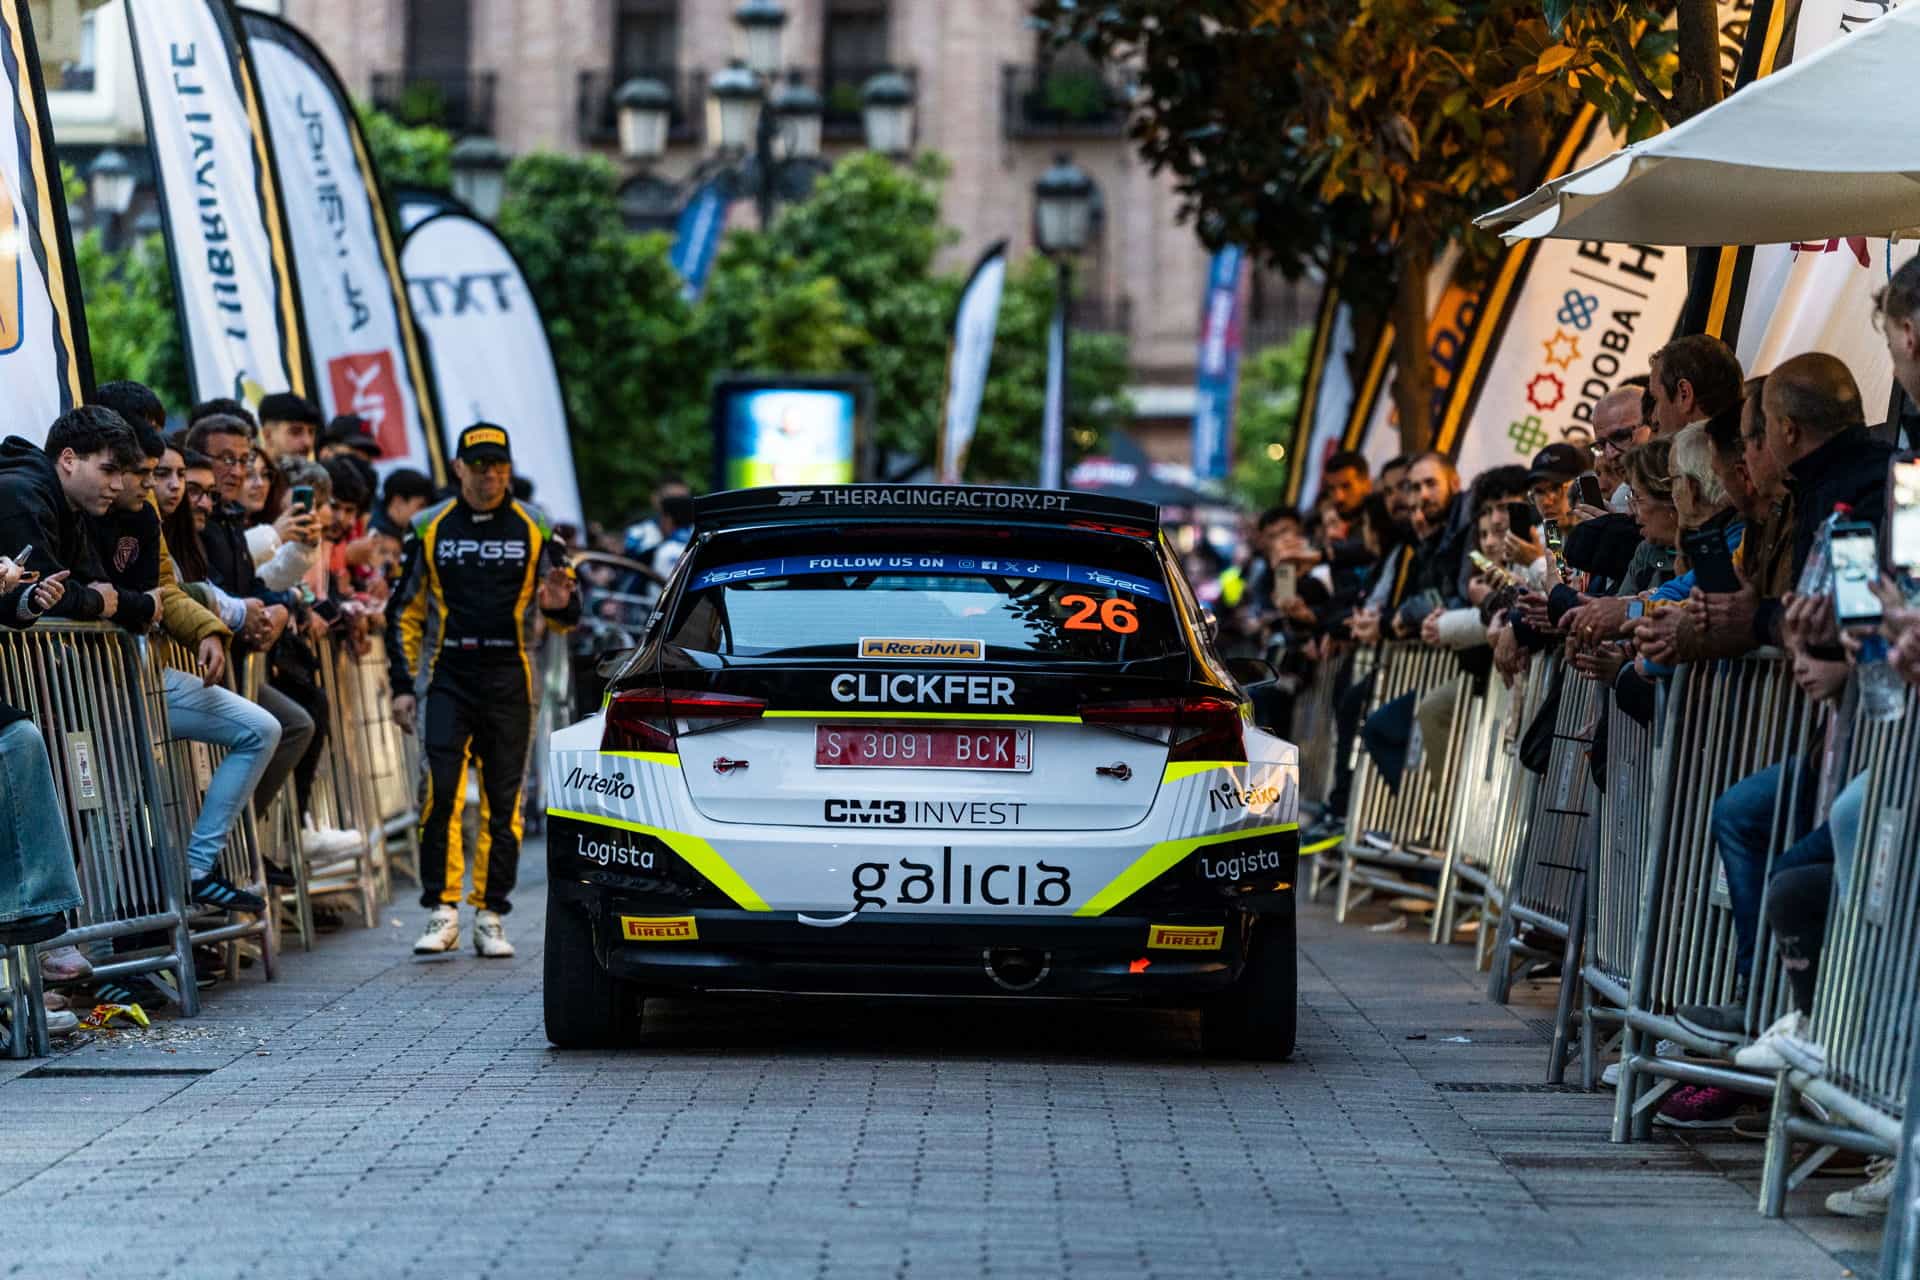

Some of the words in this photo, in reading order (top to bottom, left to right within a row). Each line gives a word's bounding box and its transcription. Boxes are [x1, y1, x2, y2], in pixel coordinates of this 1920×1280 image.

[1561, 309, 1642, 442] ÓRDOBA
[820, 489, 1071, 511] THERACINGFACTORY.PT
[711, 566, 766, 583] ERC
[809, 557, 884, 570] FOLLOW
[888, 556, 914, 570] US
[919, 556, 945, 570] ON
[1095, 573, 1151, 595] ERC
[1060, 594, 1139, 634] 26
[830, 673, 1016, 706] CLICKFER
[827, 732, 842, 758] S
[863, 733, 932, 760] 3091
[957, 735, 1009, 762] BCK
[564, 767, 635, 800] Arteixo
[824, 799, 907, 824] CM3
[914, 801, 1028, 825] INVEST
[1209, 783, 1281, 813] Arteixo
[852, 846, 1072, 913] galicia
[627, 921, 690, 937] PIRELLI
[1156, 929, 1219, 946] PIRELLI
